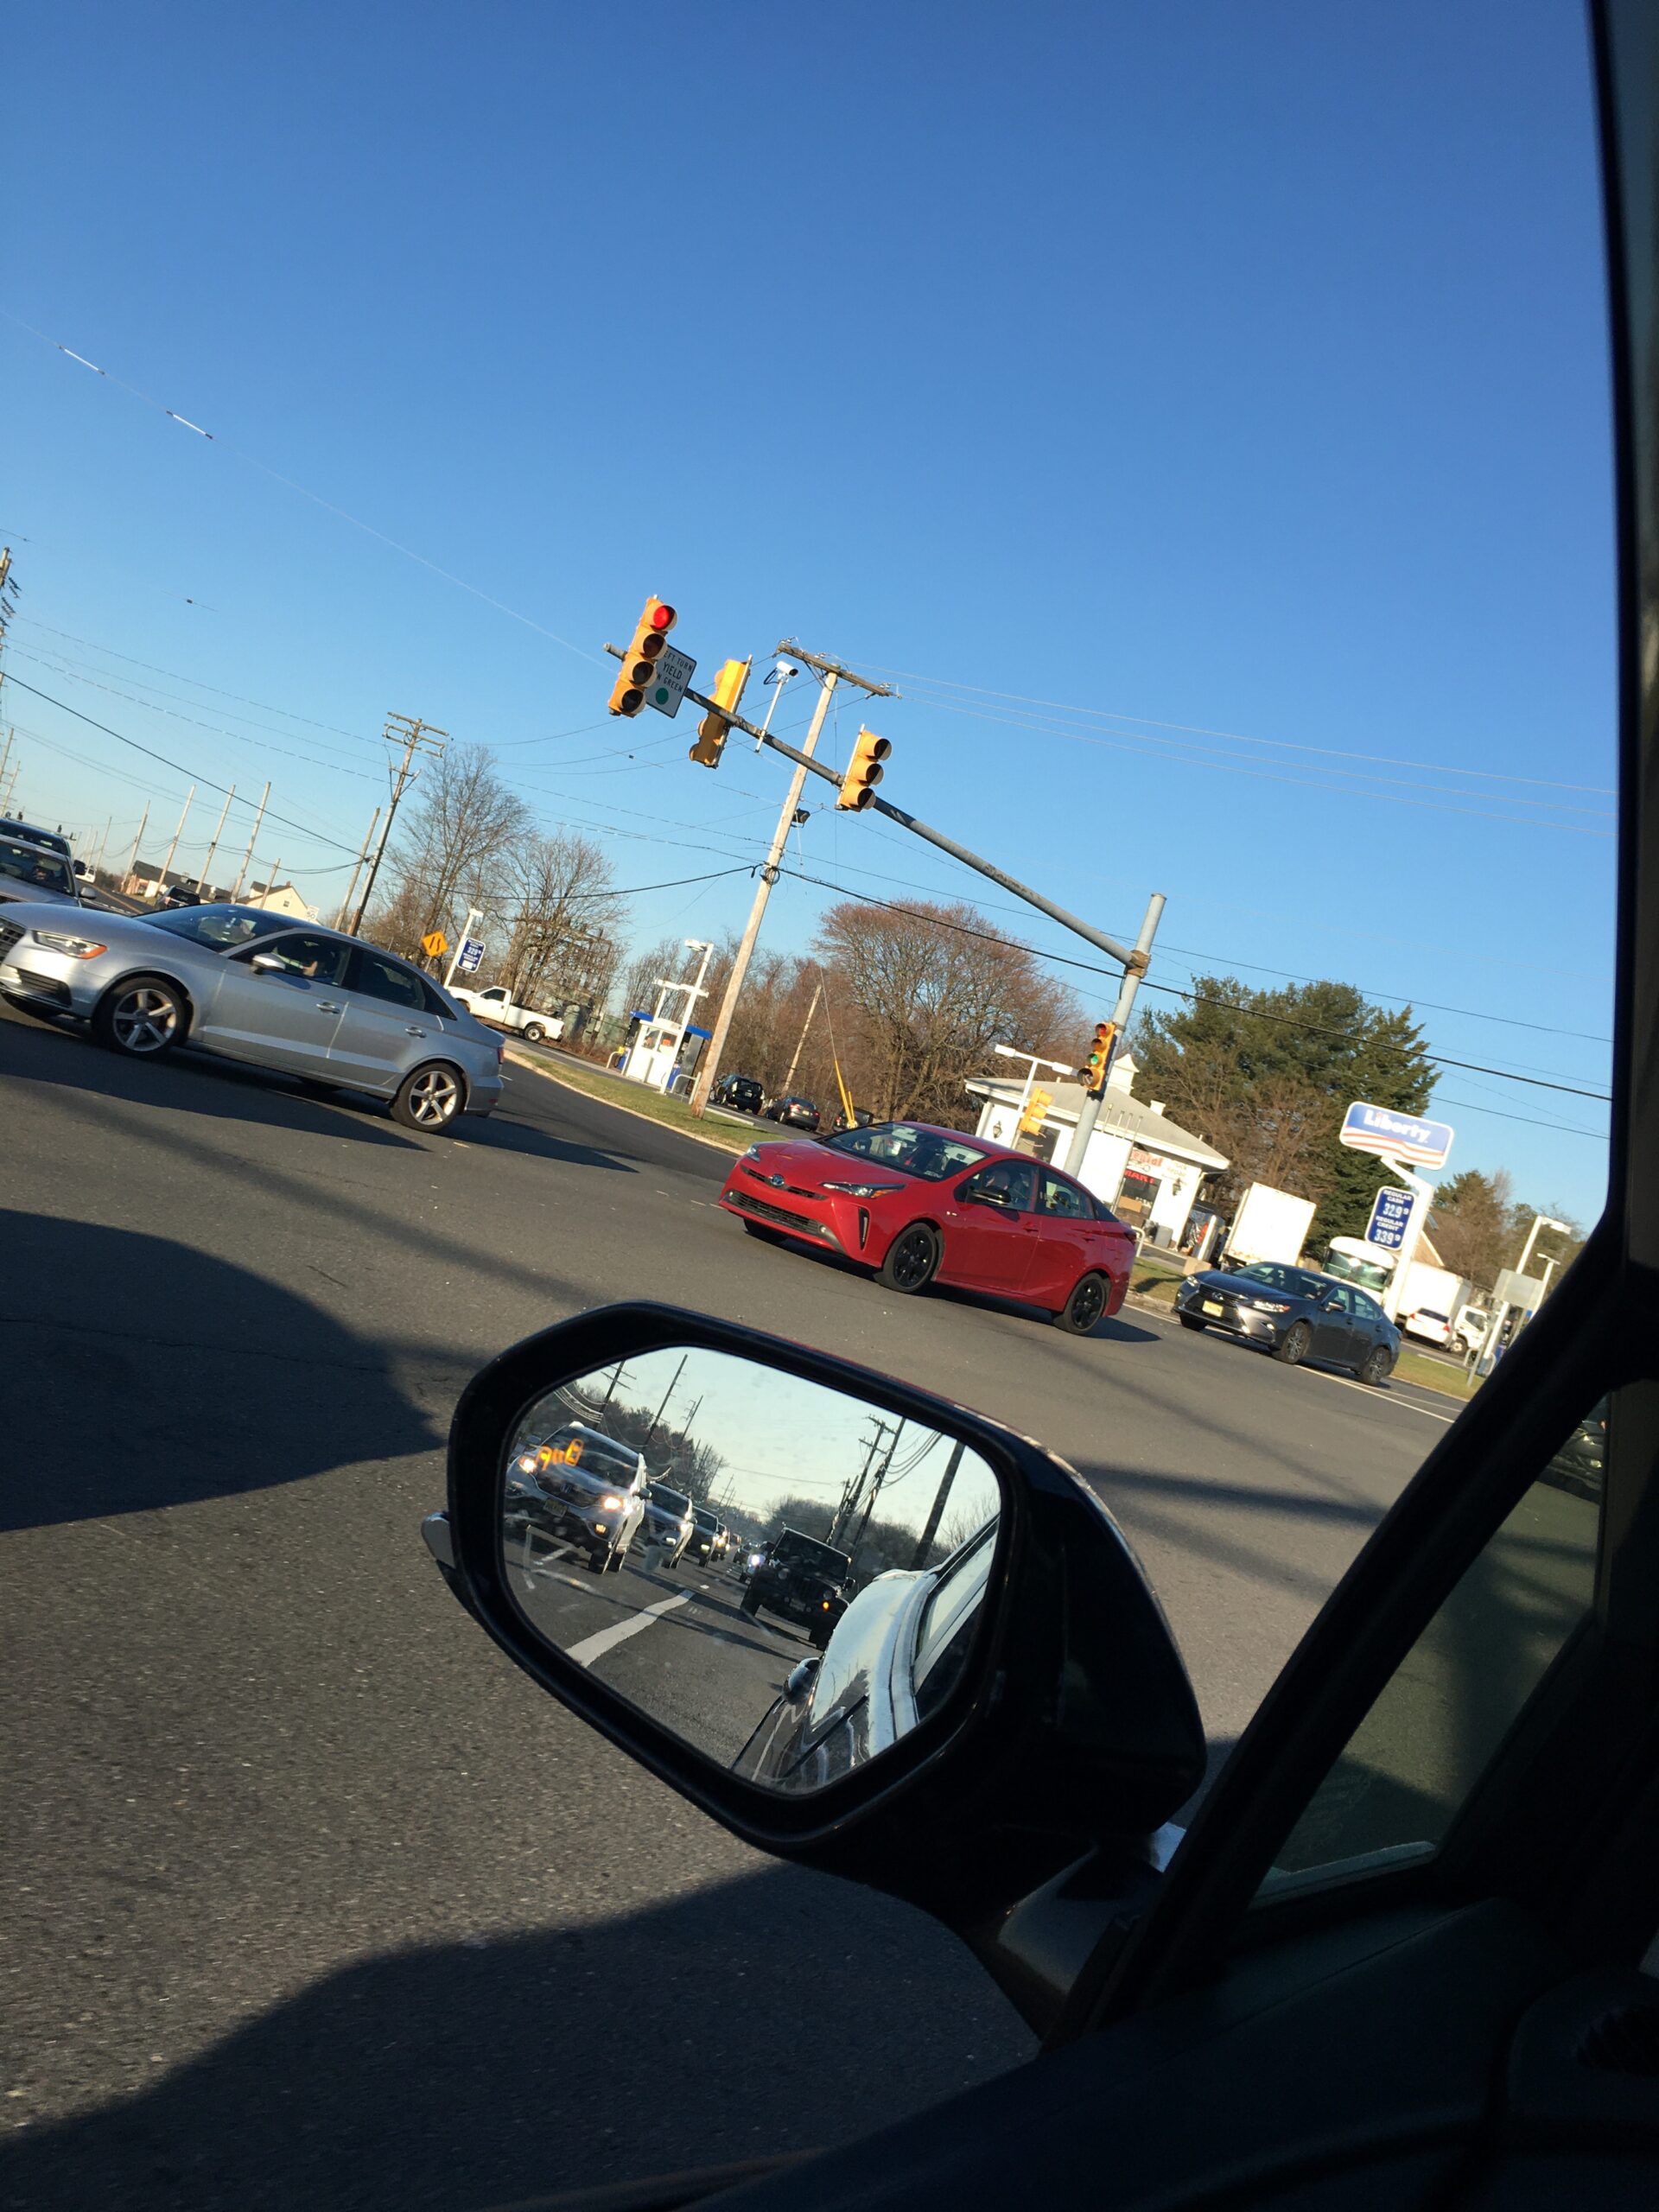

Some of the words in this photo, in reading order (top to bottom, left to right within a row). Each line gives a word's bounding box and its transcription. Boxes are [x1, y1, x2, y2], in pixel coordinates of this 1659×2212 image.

[663, 662, 683, 680] YIELD
[677, 658, 693, 672] TURN
[664, 677, 683, 692] GREEN
[1363, 1109, 1431, 1143] Liberty
[1383, 1189, 1412, 1201] REGULAR
